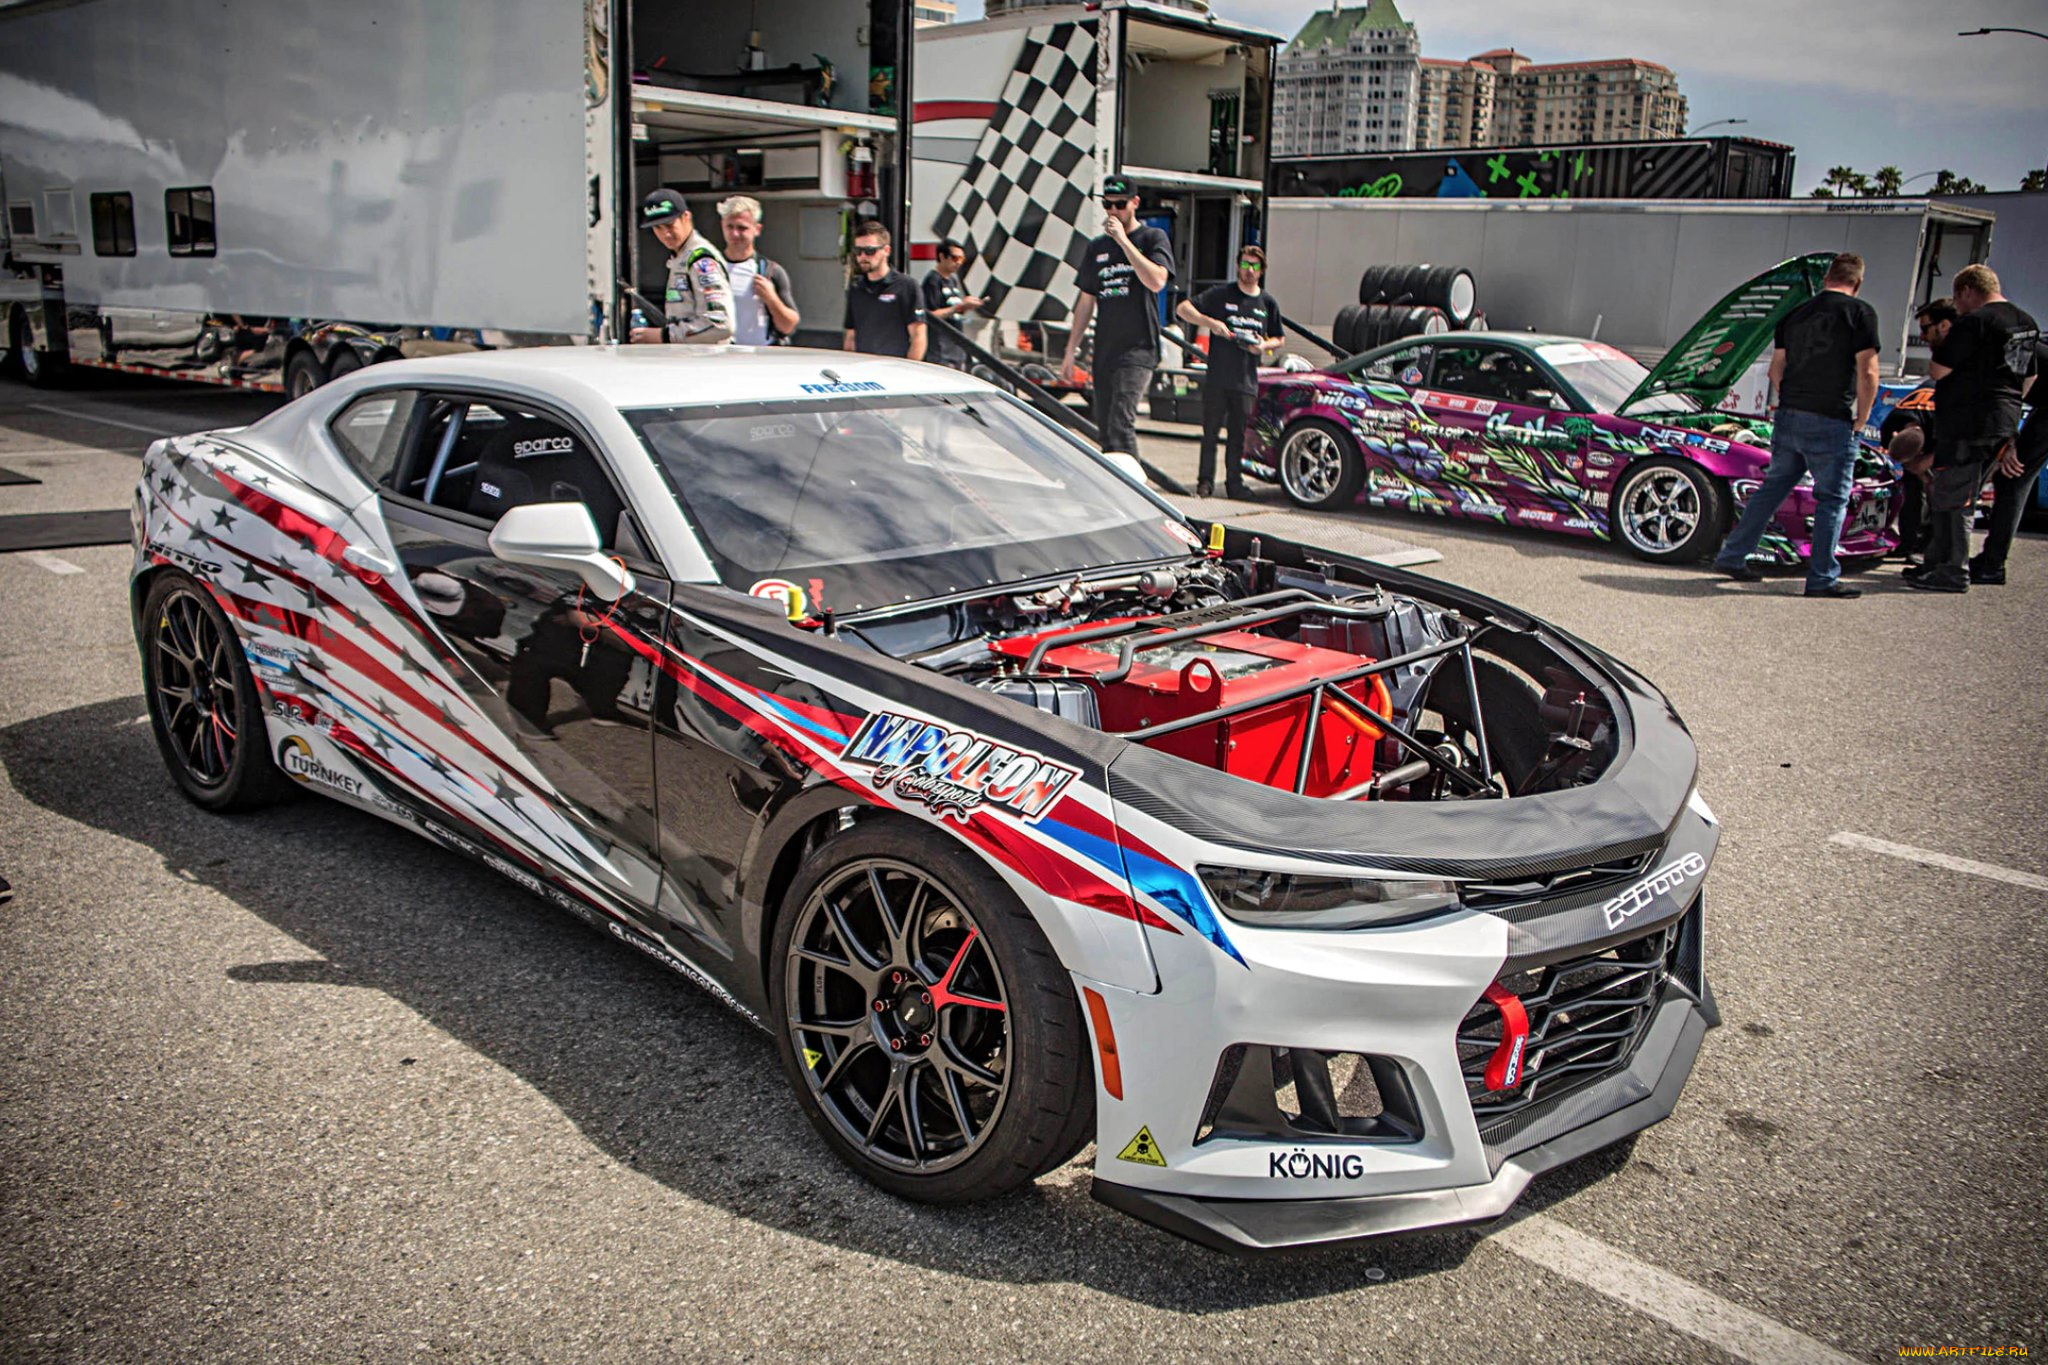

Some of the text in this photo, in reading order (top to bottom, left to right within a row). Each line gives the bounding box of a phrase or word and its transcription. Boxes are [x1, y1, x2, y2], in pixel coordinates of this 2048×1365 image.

[799, 381, 886, 394] FREEDOM
[513, 435, 574, 455] sparco
[1520, 509, 1554, 521] MOTUL
[143, 542, 223, 575] NITTO
[290, 754, 363, 795] TURNKEY
[851, 713, 1073, 815] NAPOLEON
[874, 762, 984, 820] Motorsports
[1602, 852, 1706, 931] NITTO
[1269, 1148, 1364, 1180] KÖNIG
